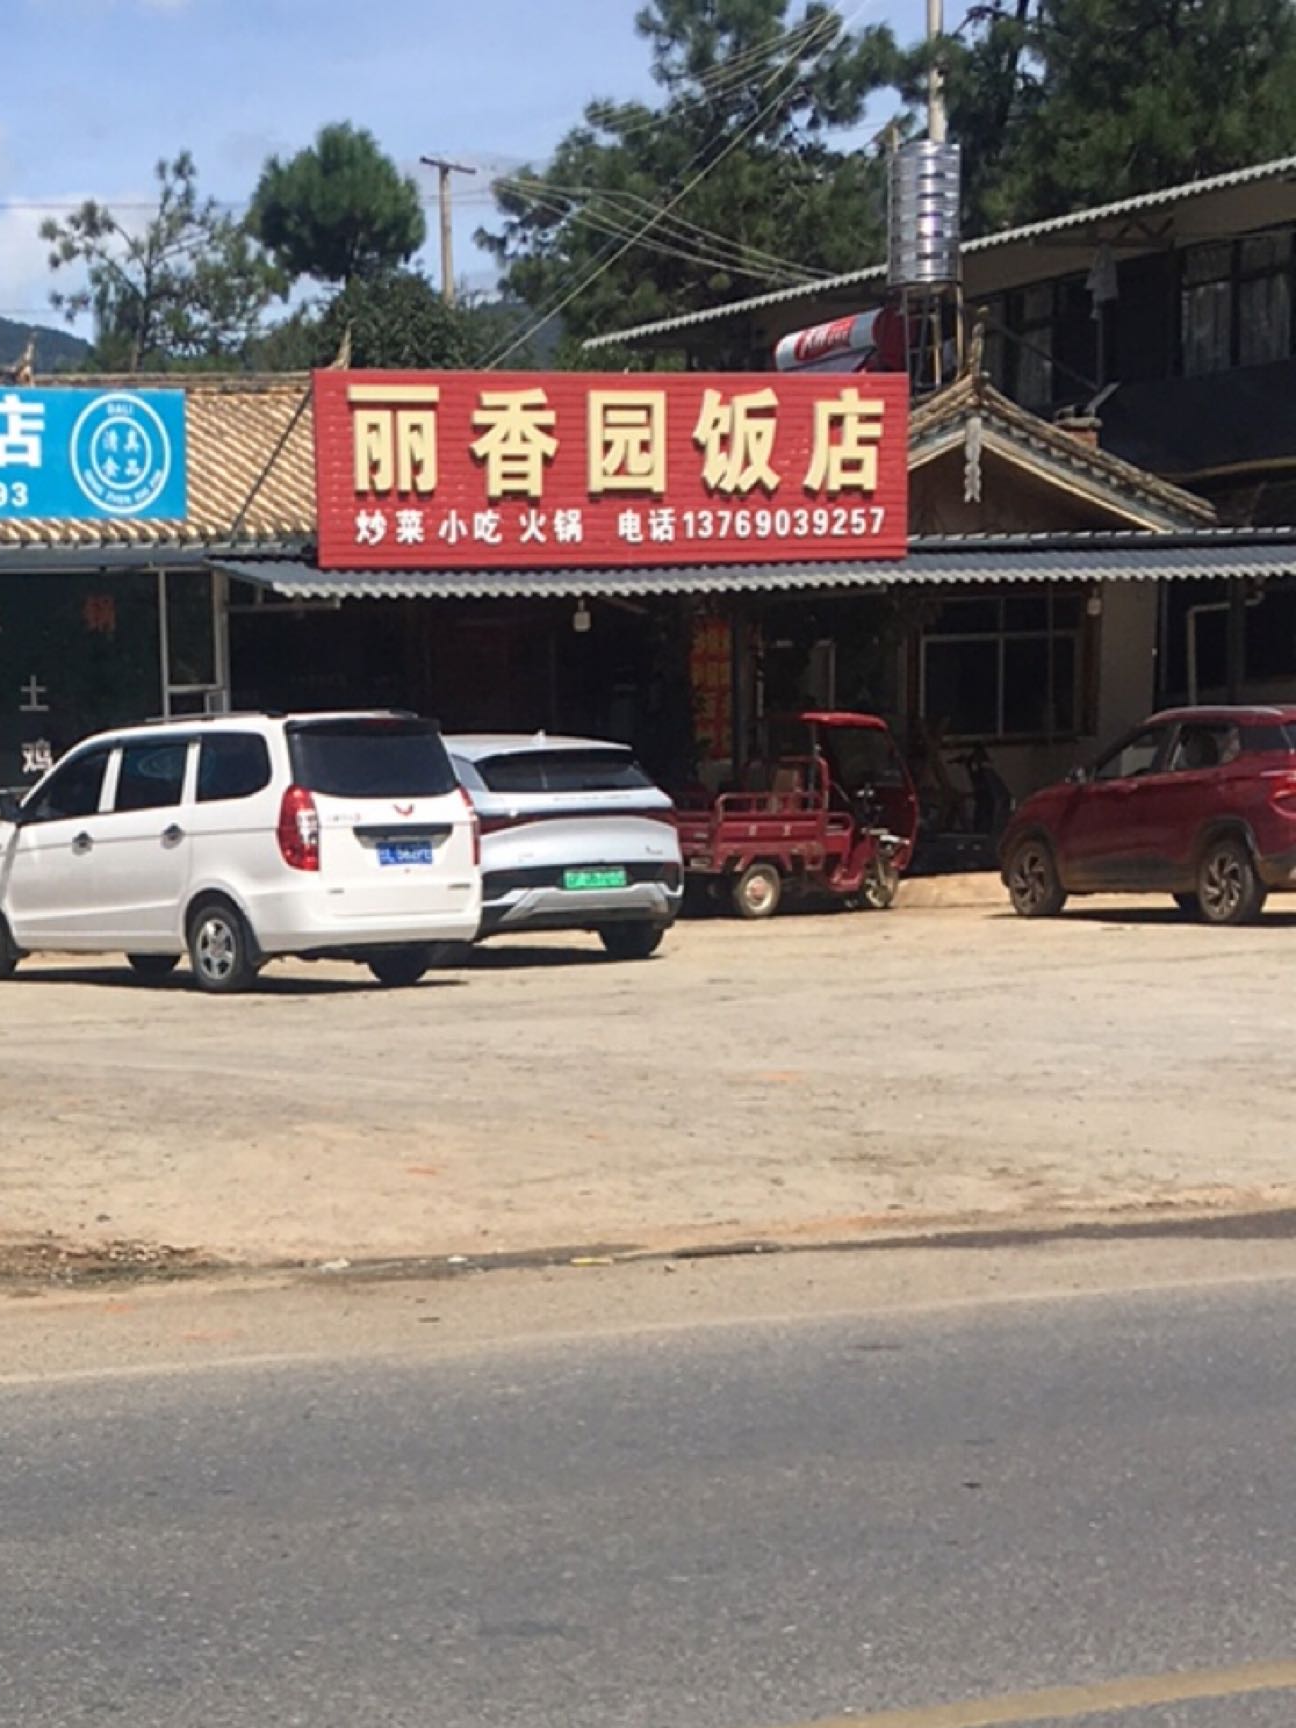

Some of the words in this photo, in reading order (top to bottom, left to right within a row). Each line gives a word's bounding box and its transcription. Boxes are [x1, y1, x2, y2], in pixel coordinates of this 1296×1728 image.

[348, 385, 886, 498] 丽香园饭店
[355, 510, 426, 545] 炒菜
[438, 510, 502, 544] 小吃
[518, 509, 584, 544] 火锅
[19, 674, 54, 774] 土鸡
